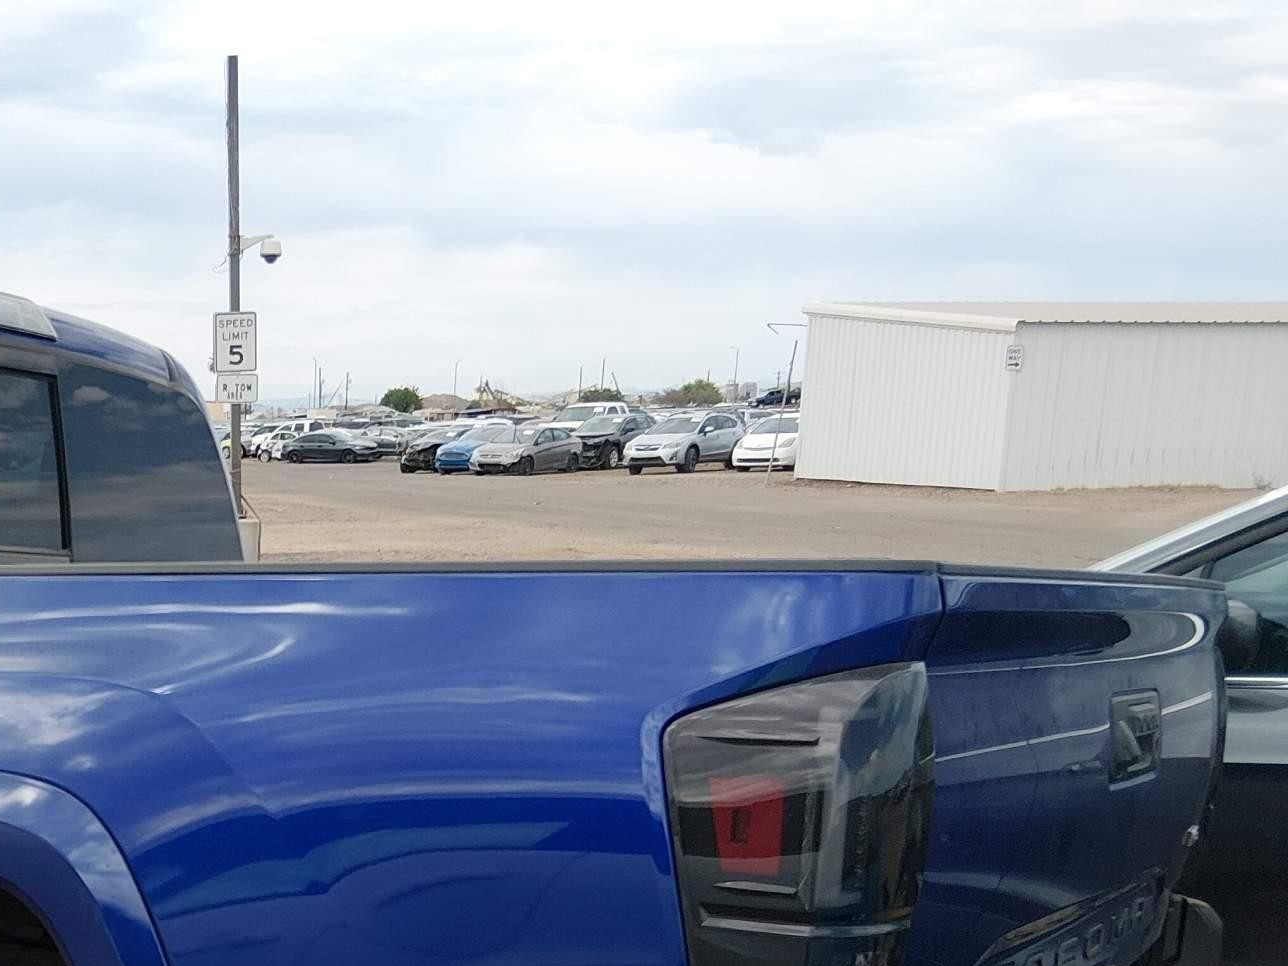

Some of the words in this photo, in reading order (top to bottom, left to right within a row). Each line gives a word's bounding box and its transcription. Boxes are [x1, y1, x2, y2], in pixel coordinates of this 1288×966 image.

[218, 318, 253, 329] SPEED
[222, 331, 249, 341] LIMIT
[228, 344, 244, 365] 5
[234, 383, 252, 392] TOW
[226, 391, 243, 400] AREA
